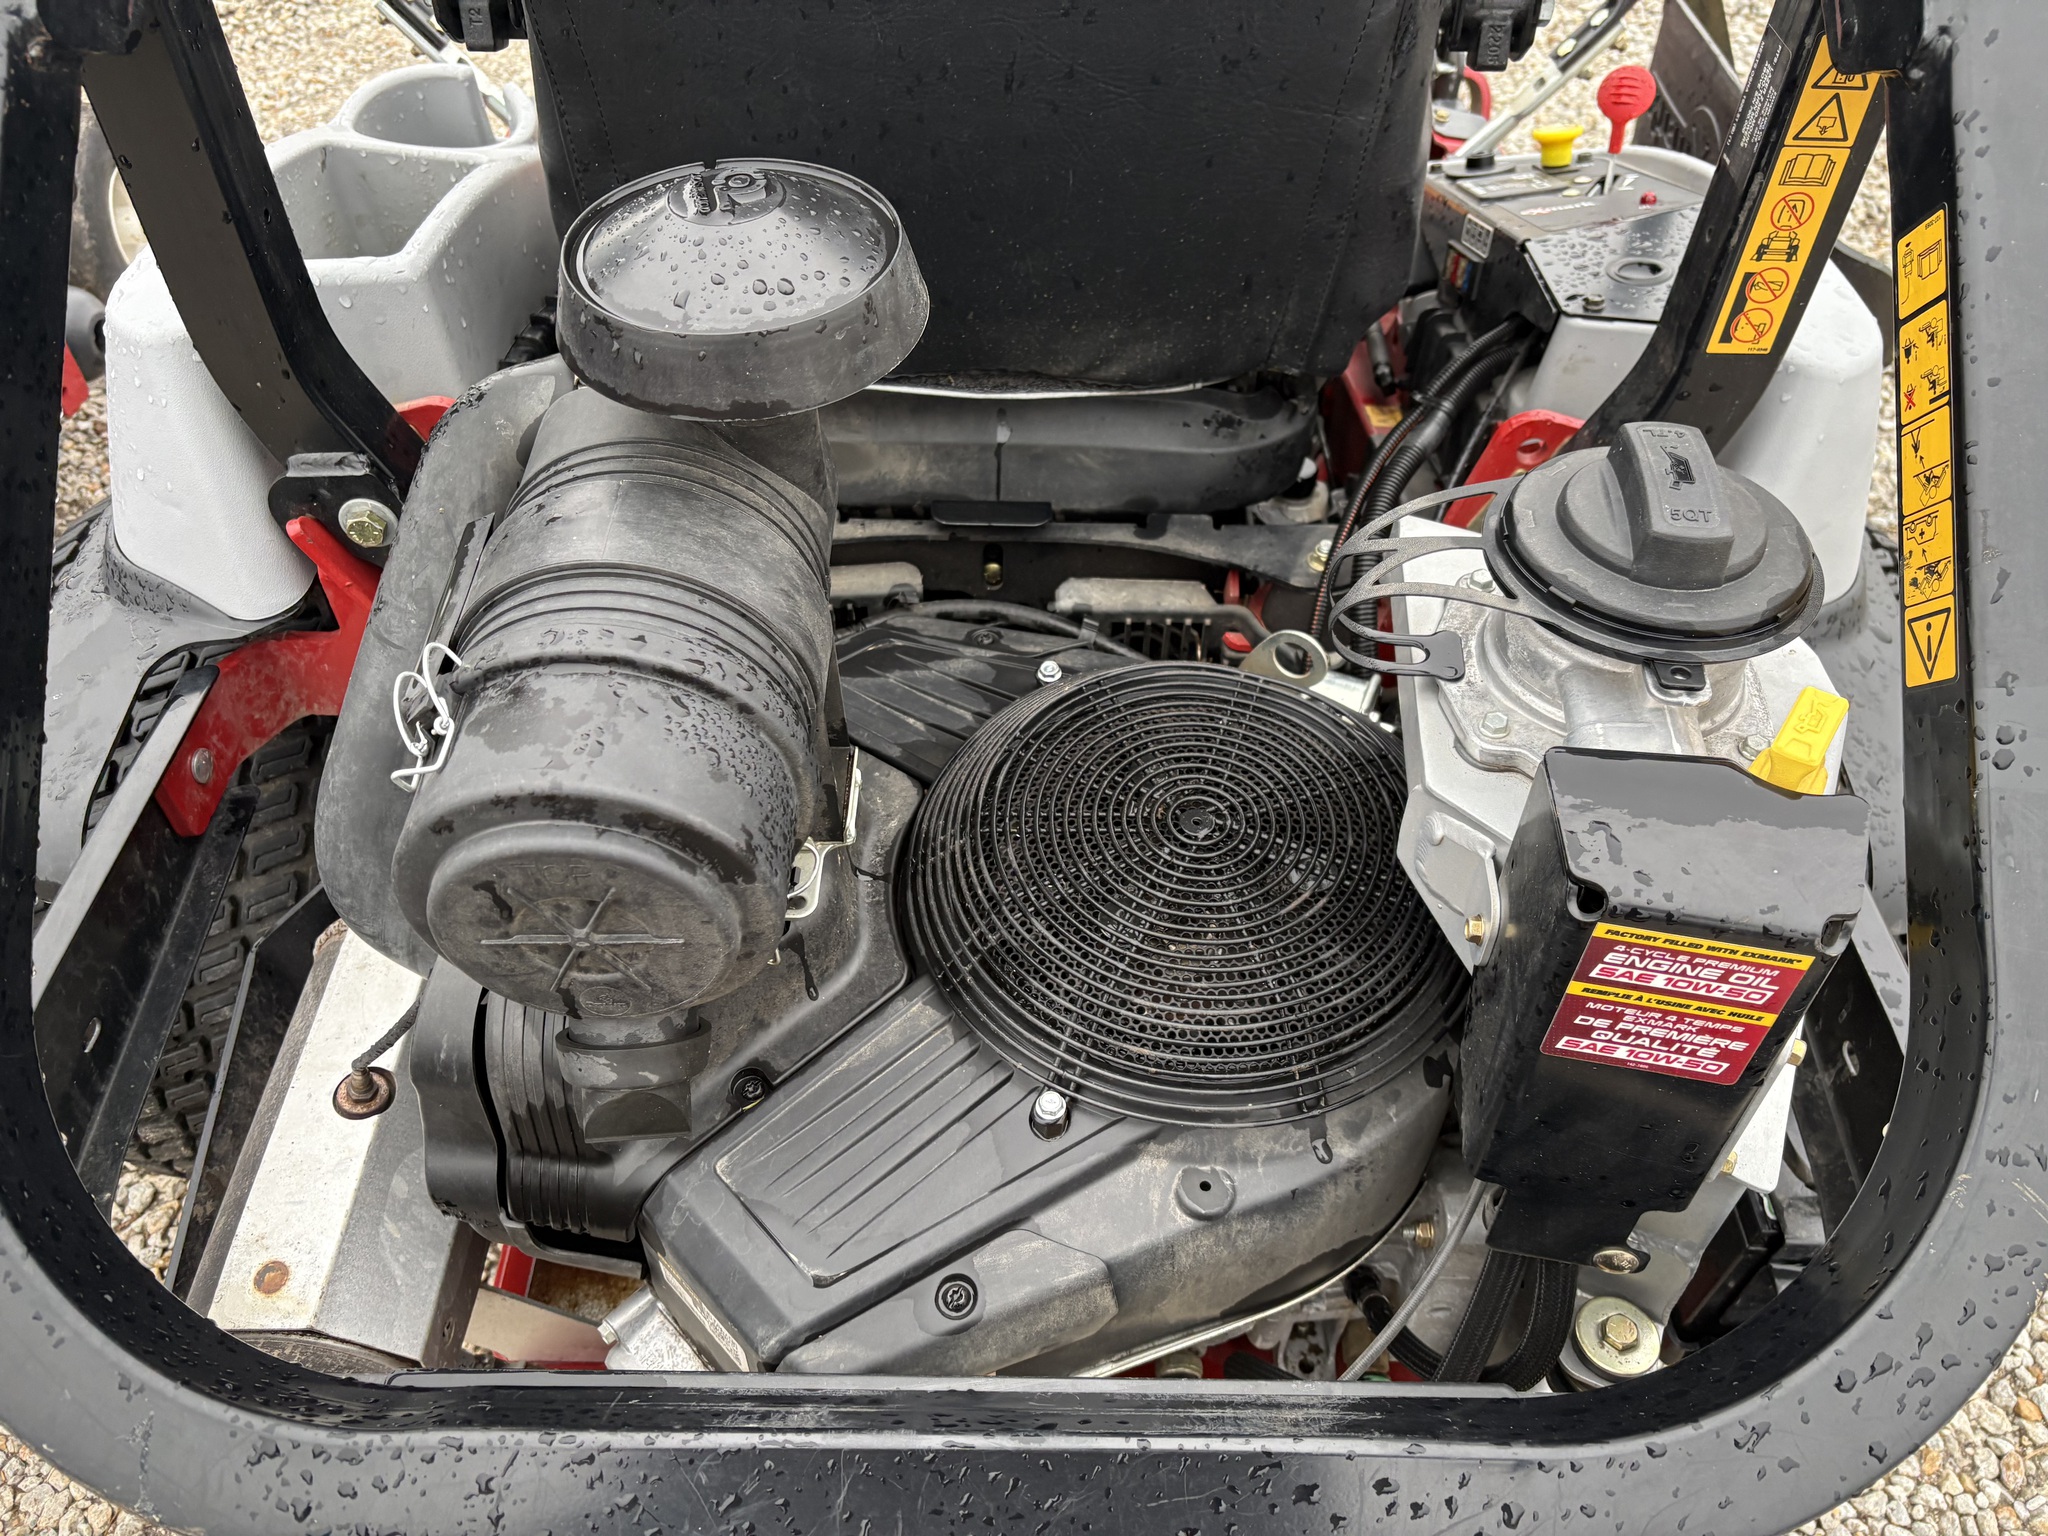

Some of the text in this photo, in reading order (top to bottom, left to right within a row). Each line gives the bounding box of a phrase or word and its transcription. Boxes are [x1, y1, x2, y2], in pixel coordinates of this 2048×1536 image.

[469, 8, 483, 25] T2
[1670, 509, 1712, 523] 5QT
[1604, 929, 1659, 946] FACTORY
[1662, 938, 1704, 951] FILLED
[1706, 944, 1739, 957] WITH
[1603, 952, 1780, 990] ENGINE OIL
[1613, 945, 1780, 977] 4-CYCLE PREMIUM
[1594, 966, 1769, 1003] SAE 10W-50
[1582, 987, 1766, 1022] REMPLIE À L'USINE AVEC HUILE
[1585, 1002, 1746, 1033] MOTEUR 4 TEMPS
[1574, 1015, 1750, 1051] DE PREMIÈRE
[1623, 1015, 1700, 1033] EXMARK
[1560, 1039, 1617, 1055] SAE
[1625, 1049, 1726, 1074] 10W-50
[1591, 1030, 1722, 1059] QUALITÉ
